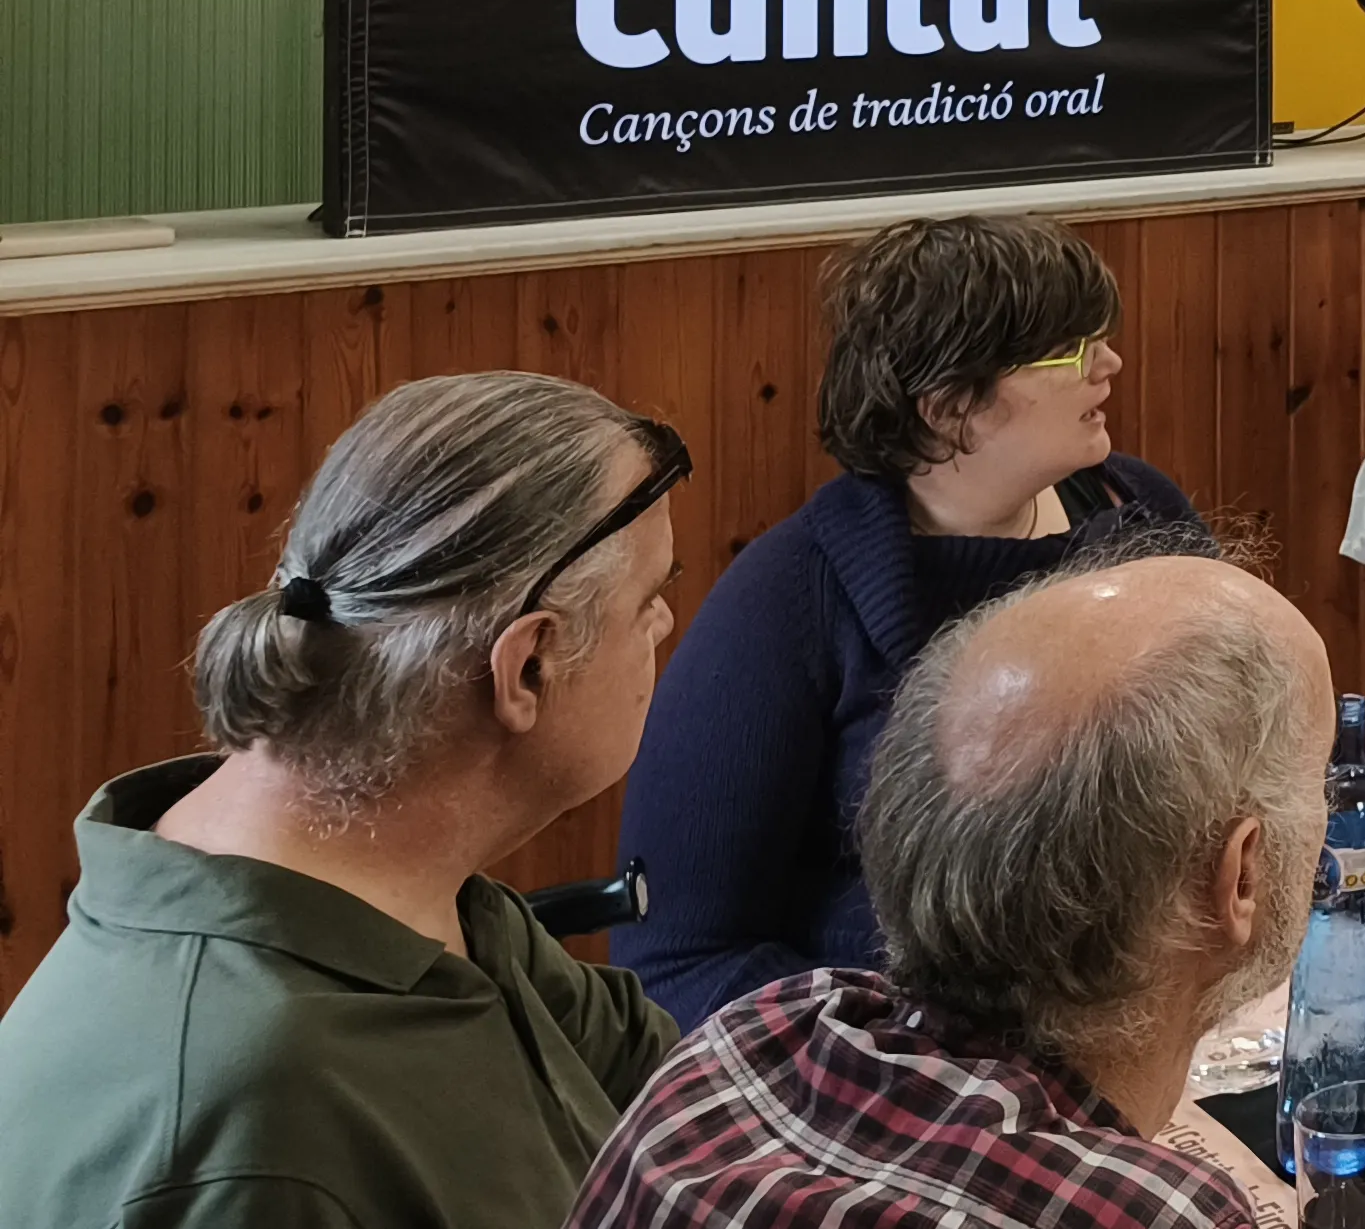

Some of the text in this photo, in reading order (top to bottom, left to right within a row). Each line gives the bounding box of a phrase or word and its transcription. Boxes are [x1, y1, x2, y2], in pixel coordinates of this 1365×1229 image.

[579, 73, 1107, 153] Cançons de tradició oral
